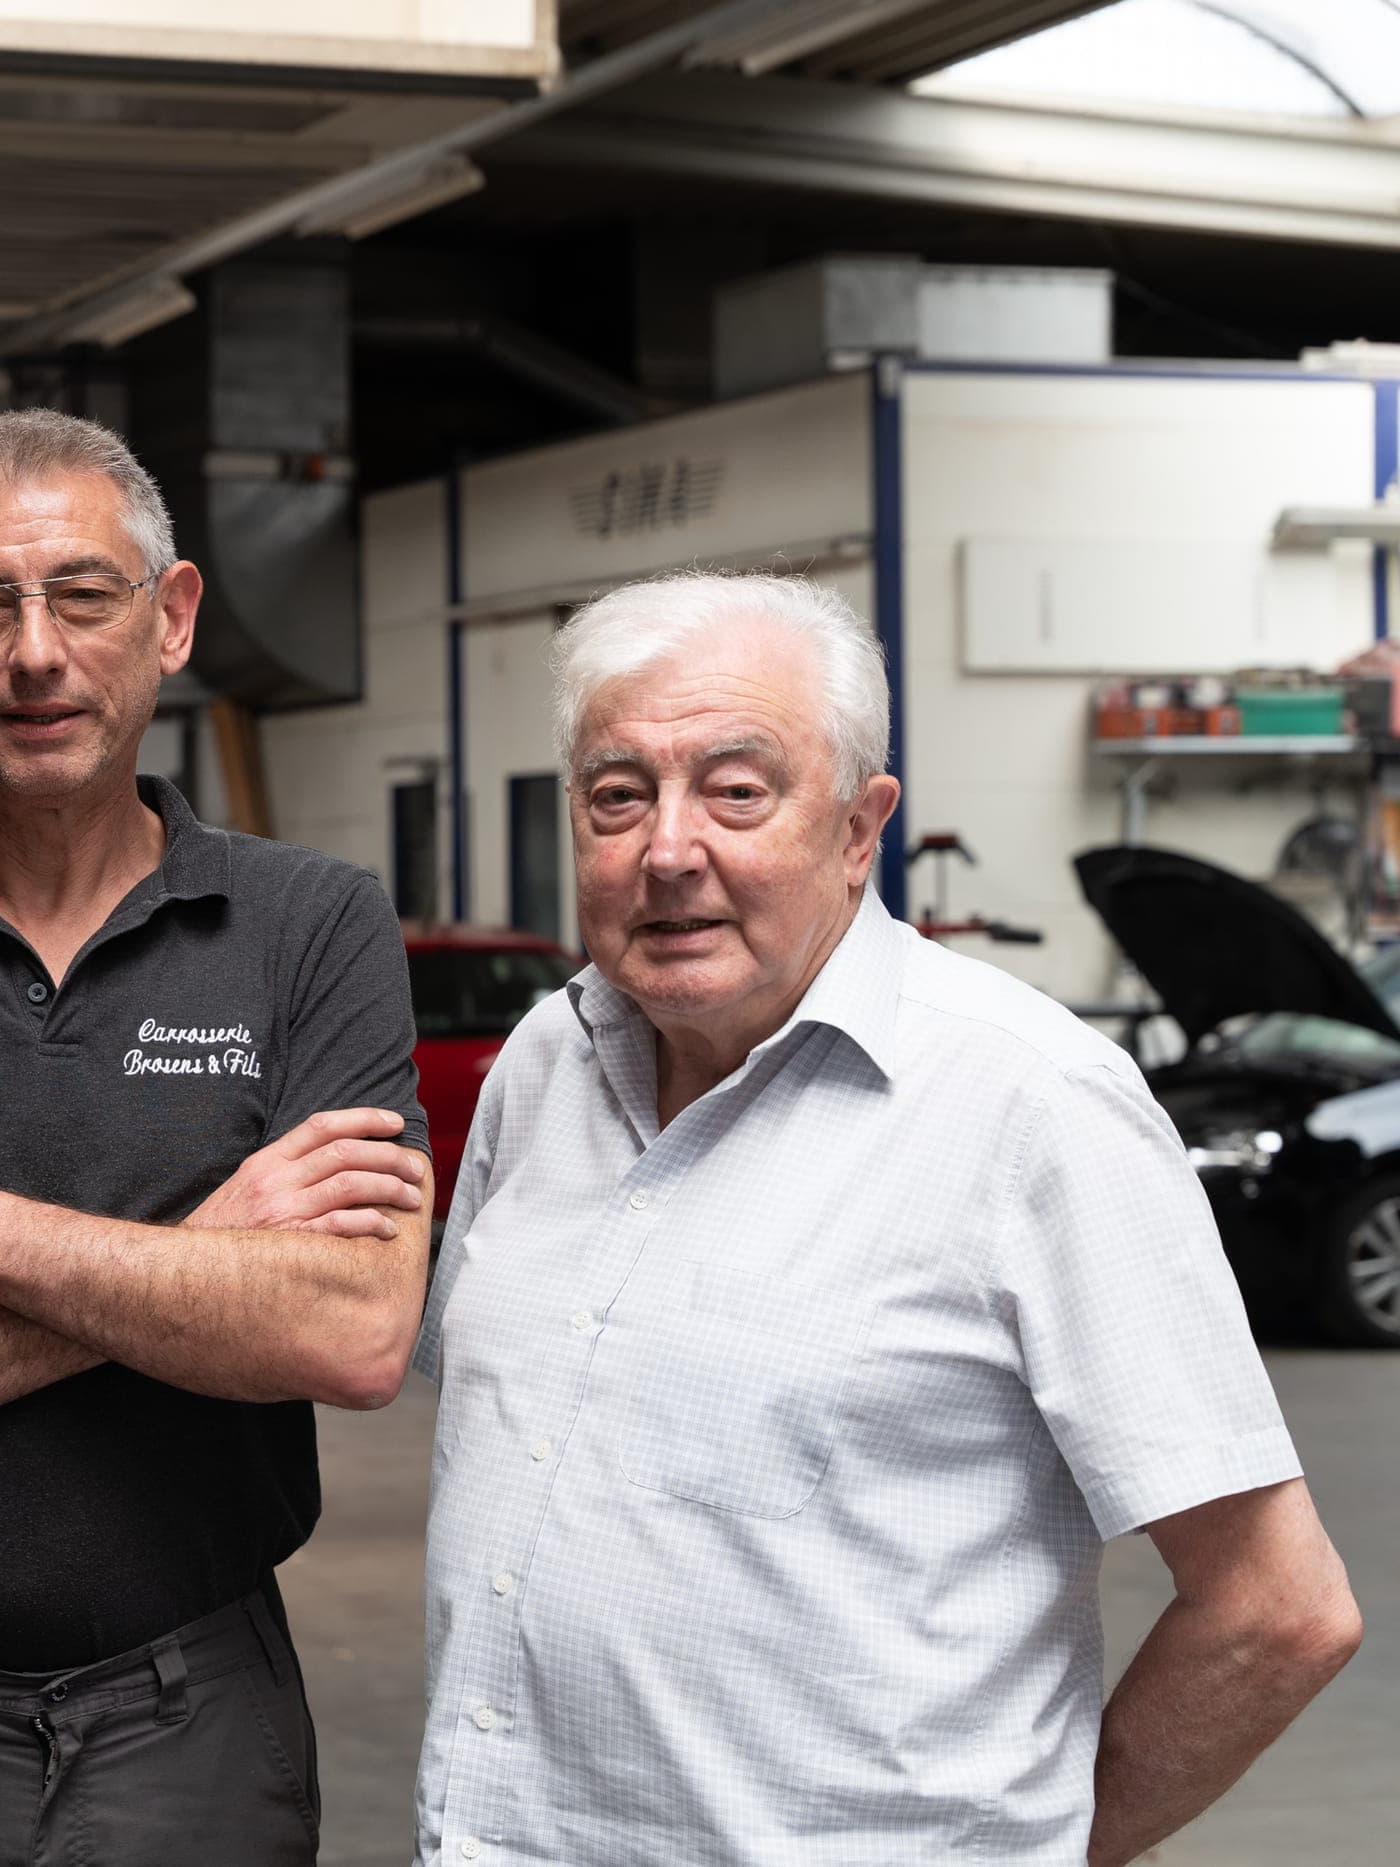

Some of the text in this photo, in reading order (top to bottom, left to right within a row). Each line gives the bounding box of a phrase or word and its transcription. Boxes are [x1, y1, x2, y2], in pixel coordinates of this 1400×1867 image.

[138, 1018, 252, 1043] Carrosserie
[123, 1048, 261, 1078] Brosens & Fils
